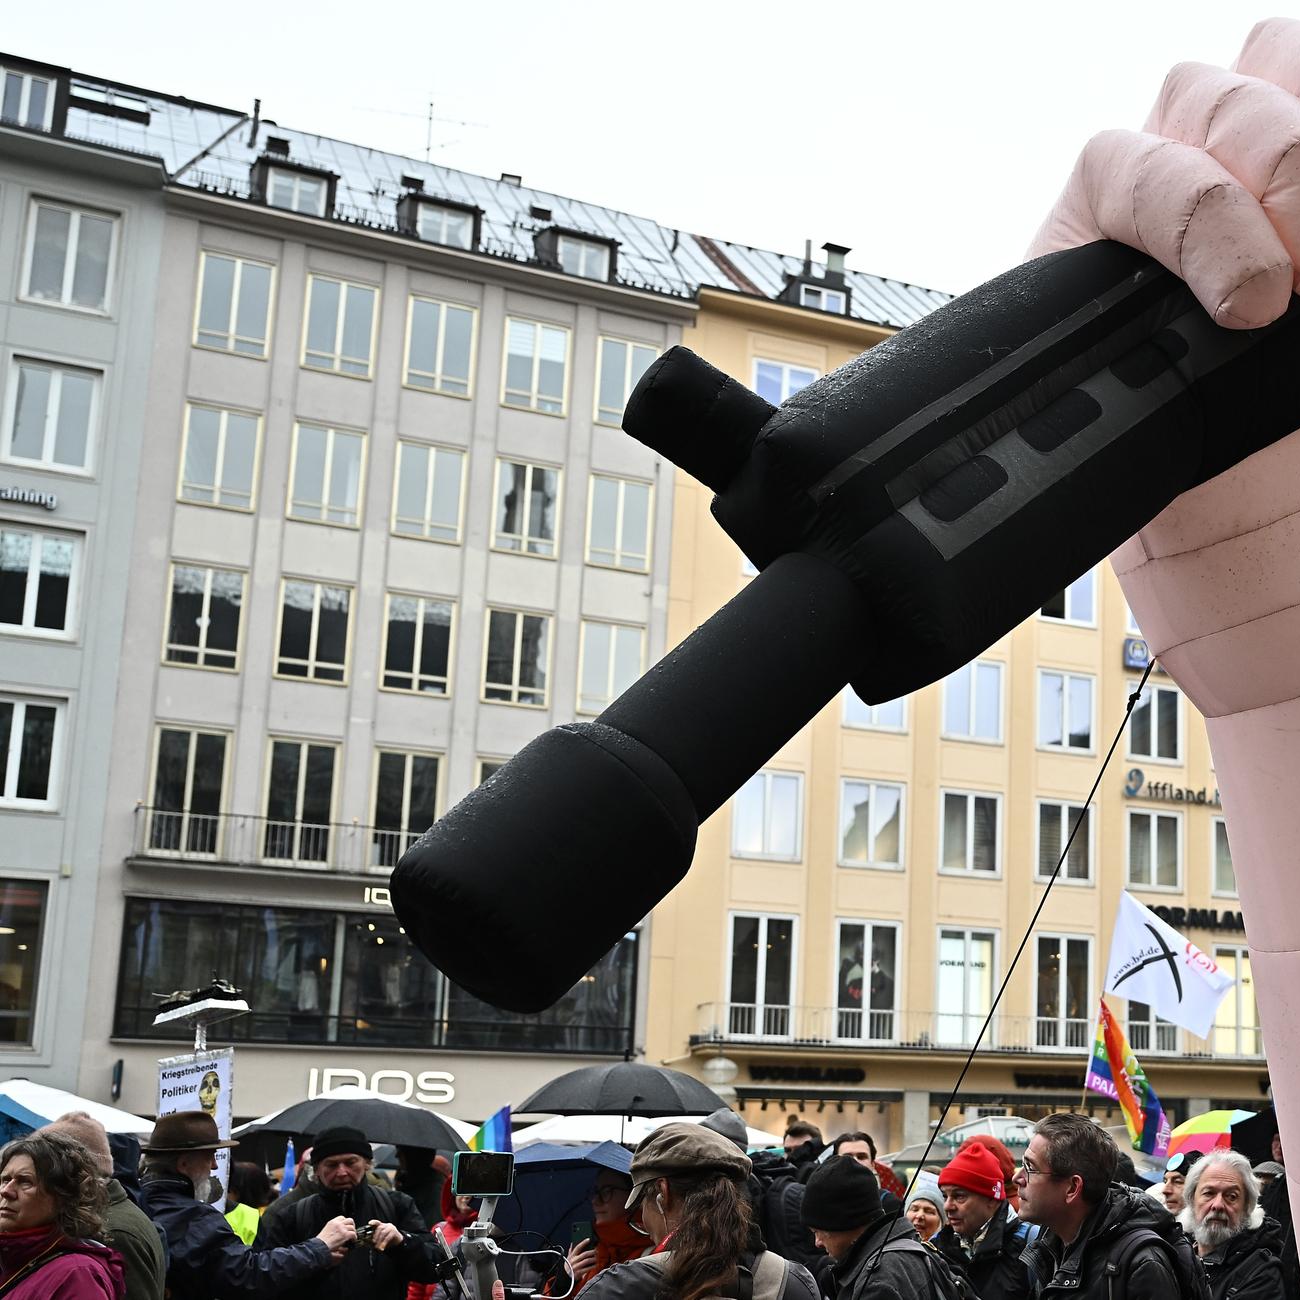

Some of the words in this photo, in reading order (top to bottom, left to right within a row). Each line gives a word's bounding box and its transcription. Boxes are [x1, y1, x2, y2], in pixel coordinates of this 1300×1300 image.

[1145, 904, 1247, 933] ORMLA
[161, 1062, 218, 1081] Kriegstreibende
[161, 1084, 198, 1099] Politiker
